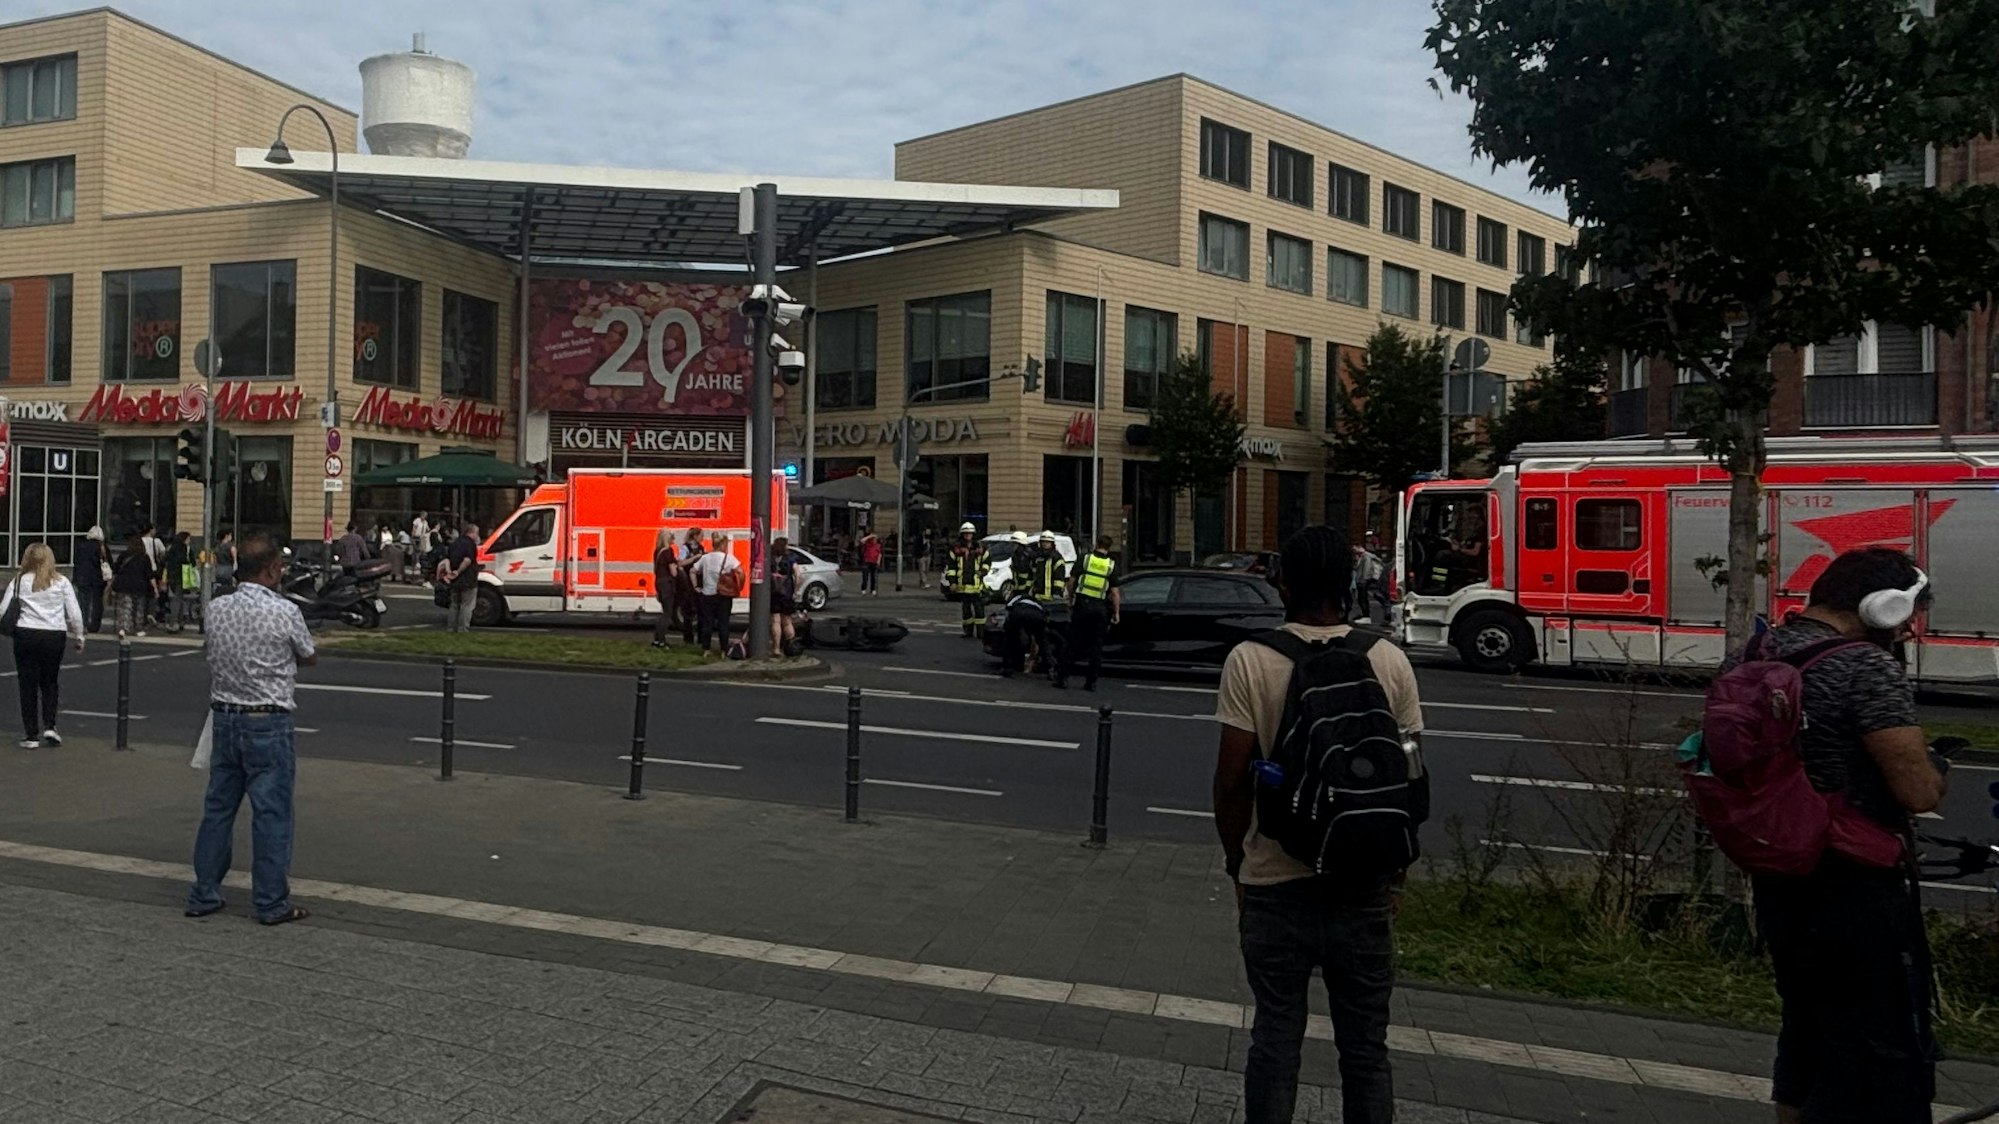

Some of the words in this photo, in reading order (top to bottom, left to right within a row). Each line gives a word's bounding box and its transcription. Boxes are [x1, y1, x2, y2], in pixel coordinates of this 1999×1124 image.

[590, 306, 703, 403] 20
[685, 374, 743, 391] JAHRE
[79, 383, 182, 424] Media
[211, 381, 304, 422] Markt
[352, 385, 436, 431] Media
[449, 398, 506, 438] Markt
[561, 422, 621, 450] KÖLN
[628, 430, 733, 452] ARCADEN
[793, 422, 867, 447] VERO
[876, 414, 977, 444] MODA
[53, 453, 67, 471] U
[1804, 495, 1833, 508] 112
